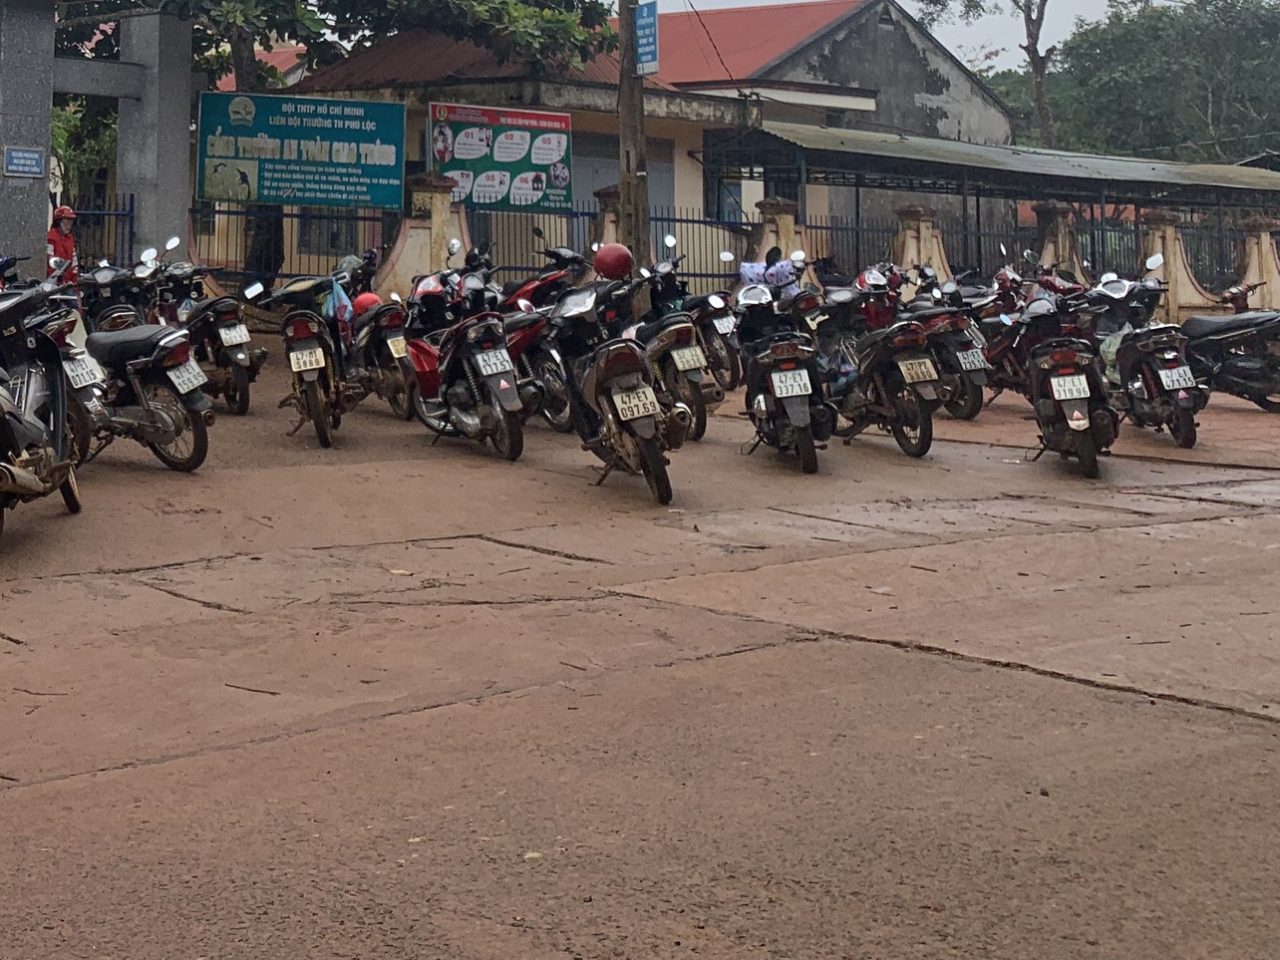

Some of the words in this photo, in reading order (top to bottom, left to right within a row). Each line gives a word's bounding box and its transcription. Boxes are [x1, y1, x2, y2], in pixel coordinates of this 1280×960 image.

[297, 103, 315, 113] TNTP
[344, 106, 365, 117] MINH
[334, 119, 344, 129] TH
[362, 120, 377, 132] LỘC
[481, 351, 505, 363] 47-E1
[69, 358, 89, 373] 47-E1
[778, 372, 803, 384] 47-E1
[1057, 377, 1083, 388] 47-E1
[778, 382, 809, 396] 337.16
[620, 390, 650, 406] 47-E1
[620, 401, 658, 420] 097.69
